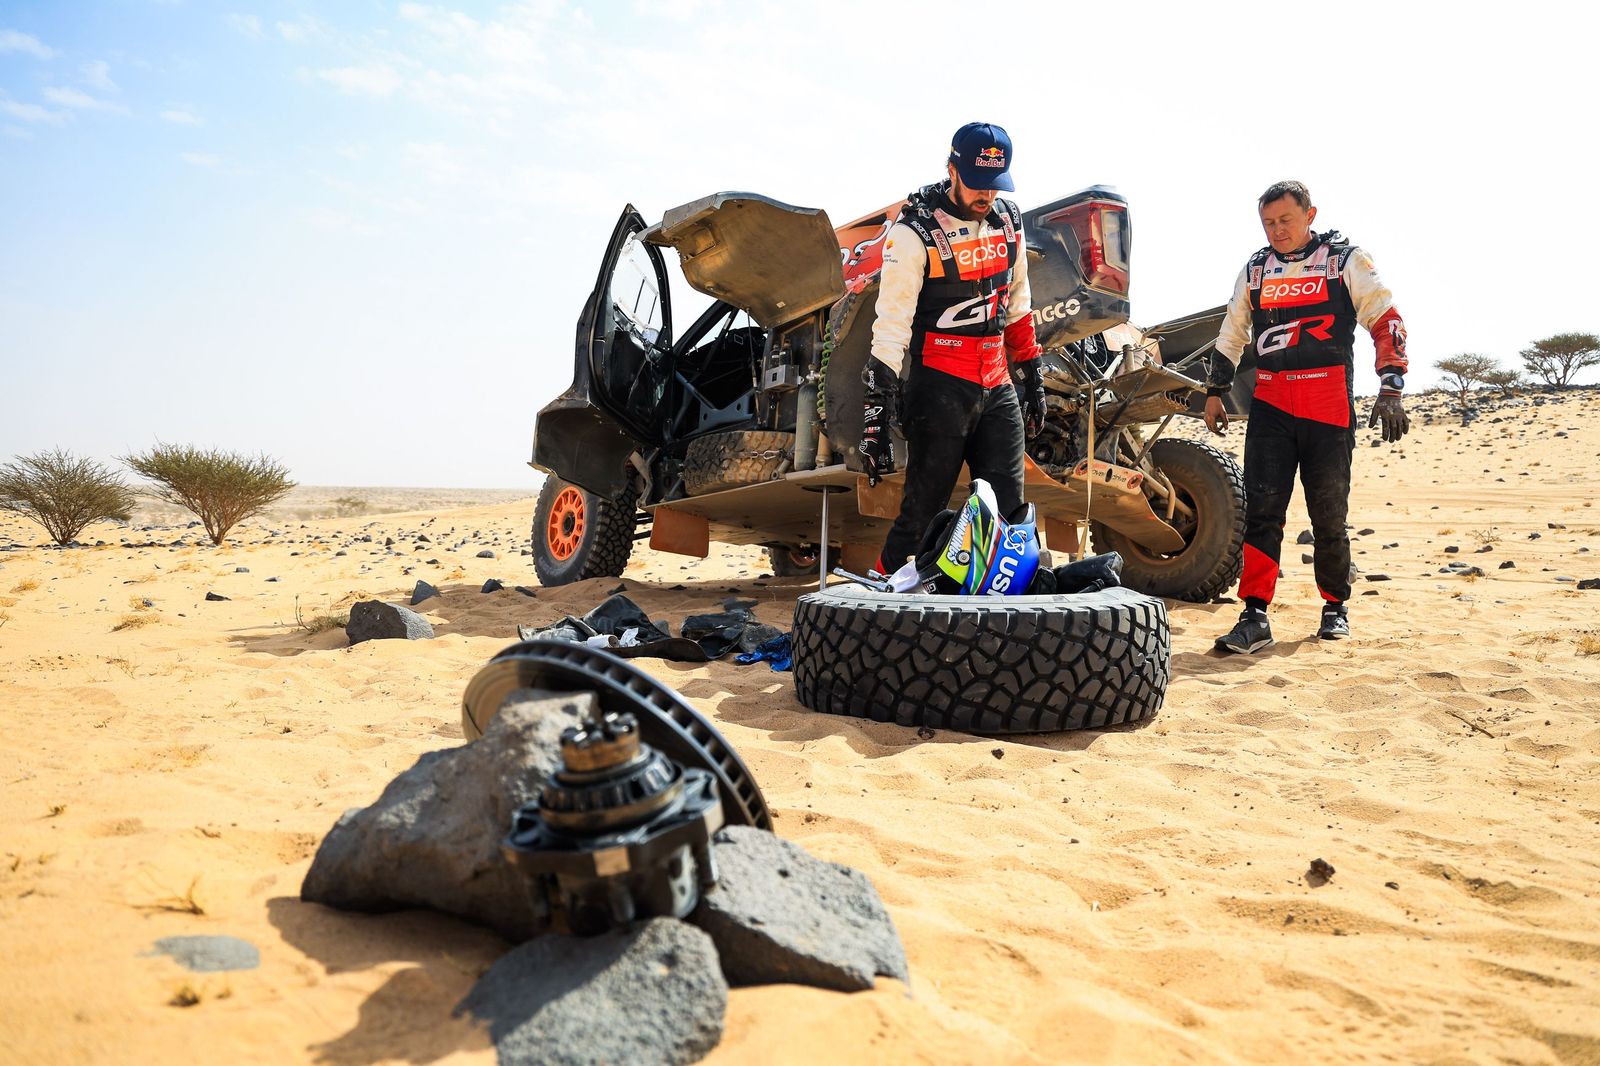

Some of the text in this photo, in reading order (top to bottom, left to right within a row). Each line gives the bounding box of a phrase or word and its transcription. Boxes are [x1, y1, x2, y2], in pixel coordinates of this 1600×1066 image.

[975, 157, 1005, 168] Red Bull
[911, 221, 931, 242] sparco
[935, 230, 949, 256] SIMPSON
[953, 243, 1008, 268] epso
[1262, 277, 1324, 300] epsol
[934, 338, 963, 347] sparco
[1256, 314, 1335, 356] GR
